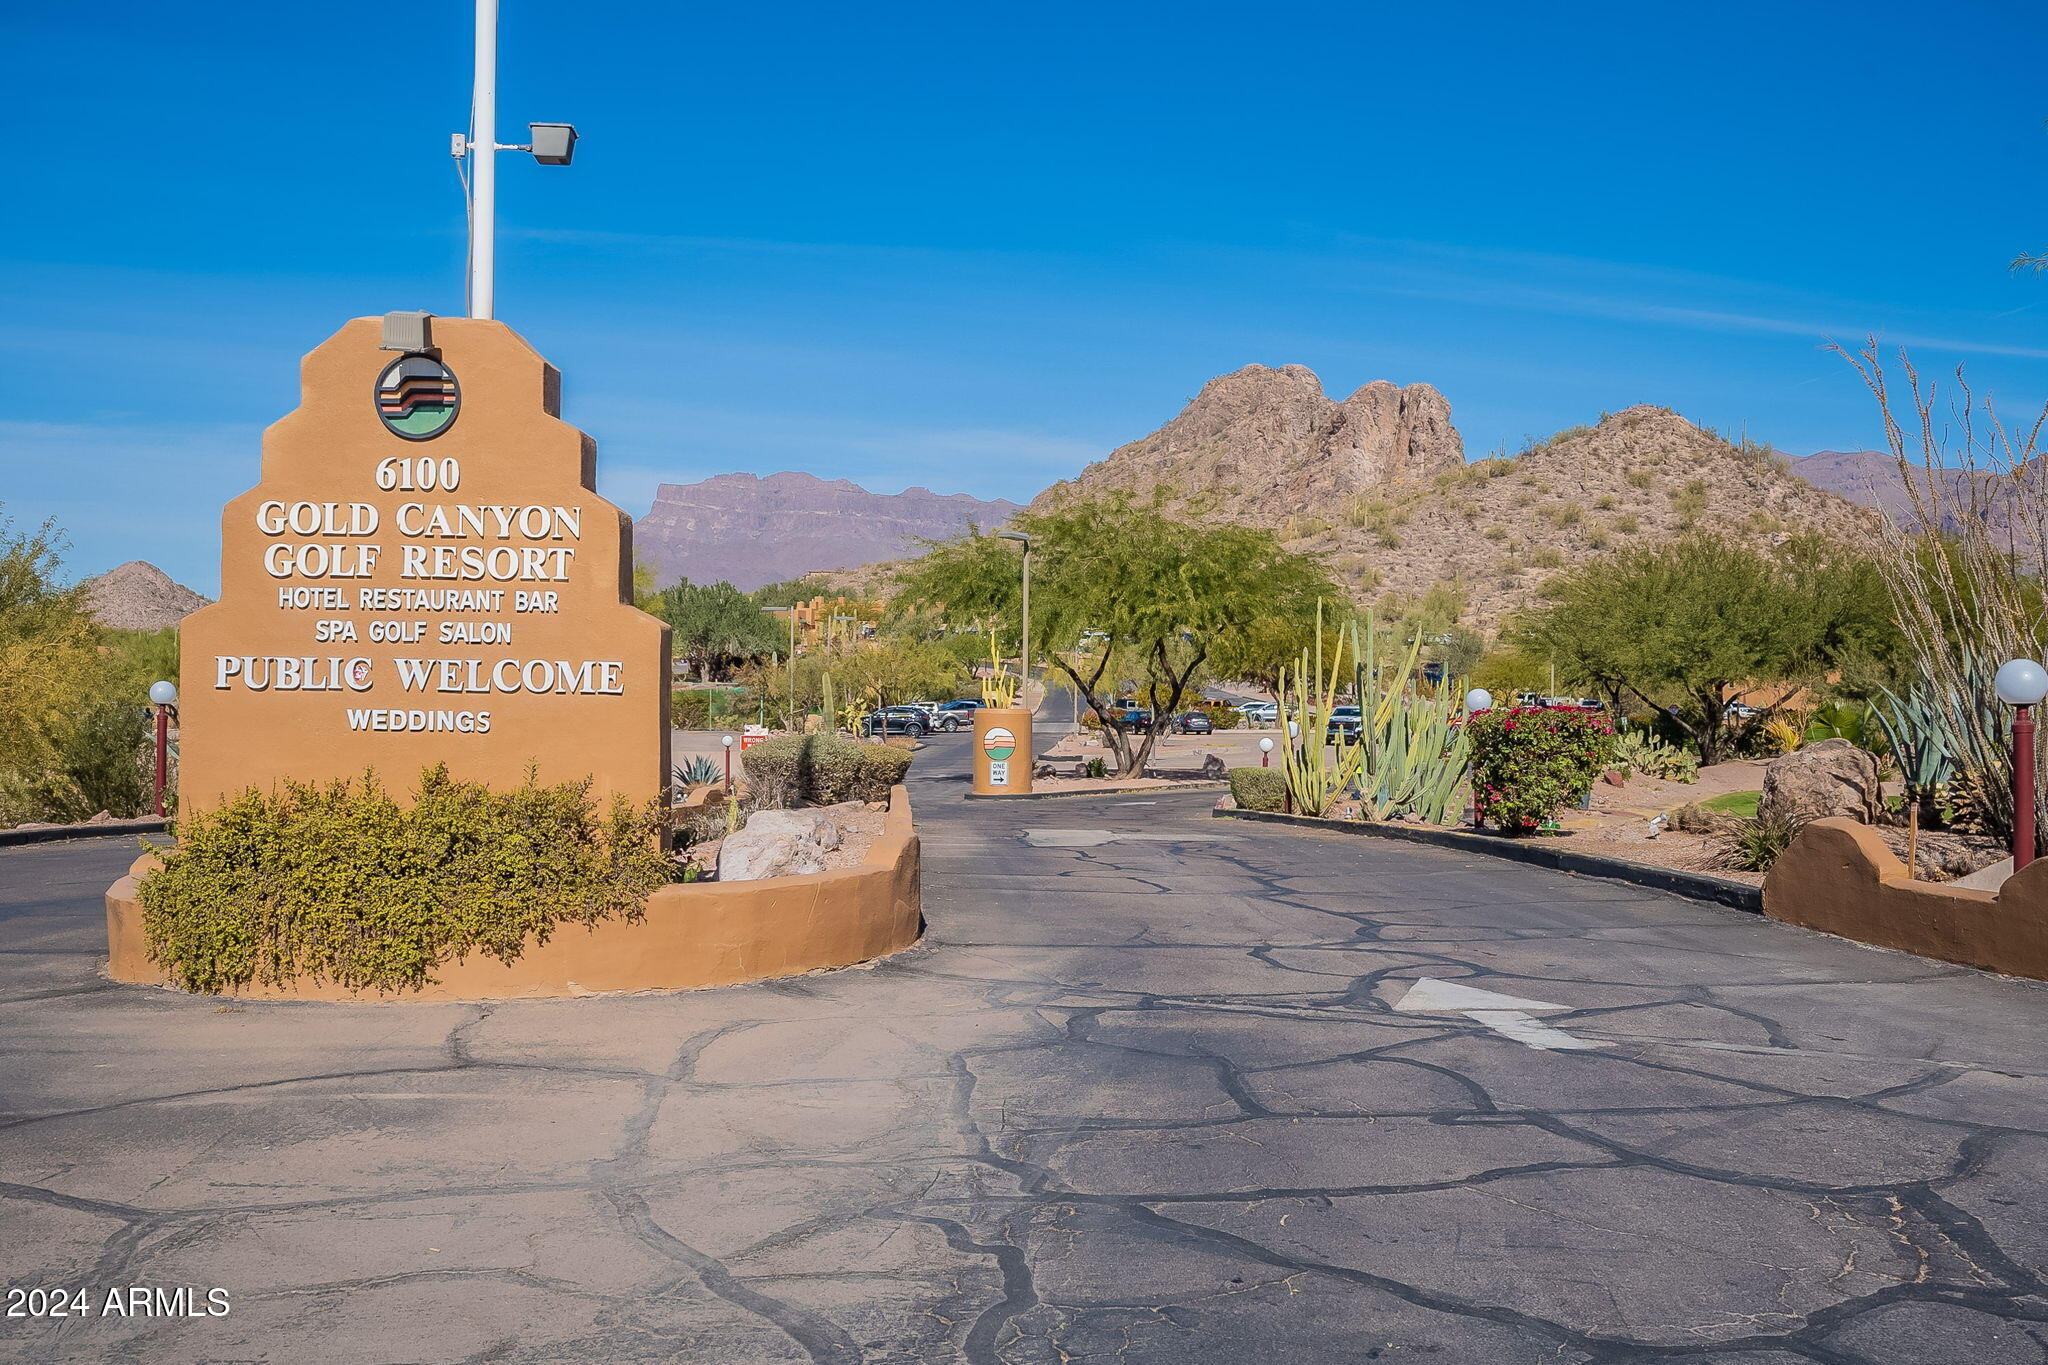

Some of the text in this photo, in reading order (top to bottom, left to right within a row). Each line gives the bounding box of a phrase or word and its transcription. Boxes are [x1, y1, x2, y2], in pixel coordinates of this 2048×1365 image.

[375, 456, 460, 490] 6100
[256, 500, 581, 538] GOLD CANYON
[264, 543, 575, 581] GOLF RESORT
[278, 586, 558, 613] HOTEL RESTAURANT BAR
[314, 619, 511, 643] SPA GOLF SALON
[213, 655, 624, 695] PUBLIC WELCOME
[346, 708, 491, 732] WEDDINGS
